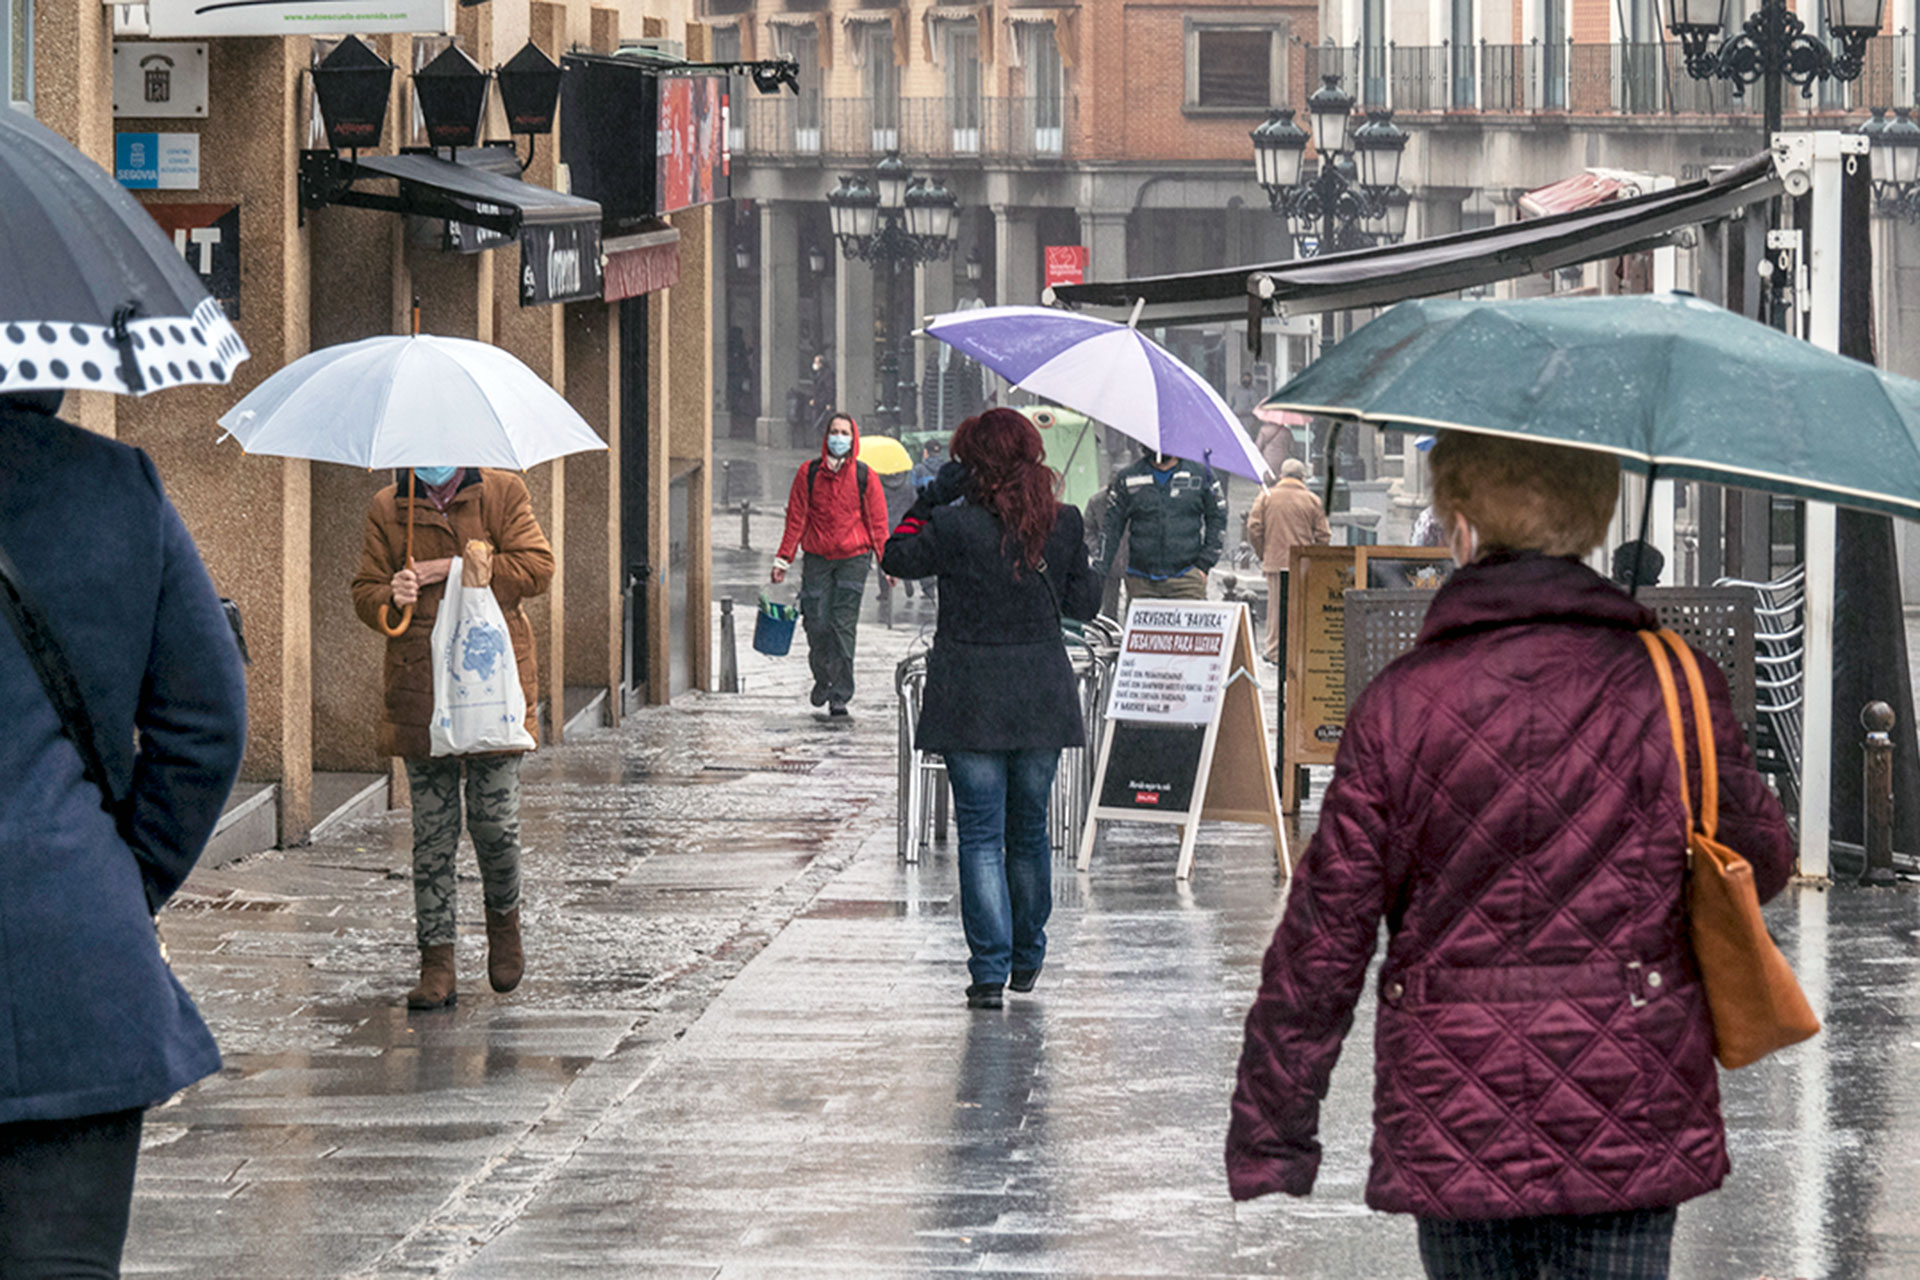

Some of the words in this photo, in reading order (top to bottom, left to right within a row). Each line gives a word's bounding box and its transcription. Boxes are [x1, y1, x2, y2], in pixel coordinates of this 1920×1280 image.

[284, 12, 408, 21] www.autoescuela-avenida.com
[117, 169, 158, 181] SEGOVIA
[1132, 608, 1181, 627] CERVECERÍA
[1129, 633, 1174, 651] DESAYUNOS
[1173, 635, 1194, 652] PARA
[1194, 636, 1221, 653] LLEVAR
